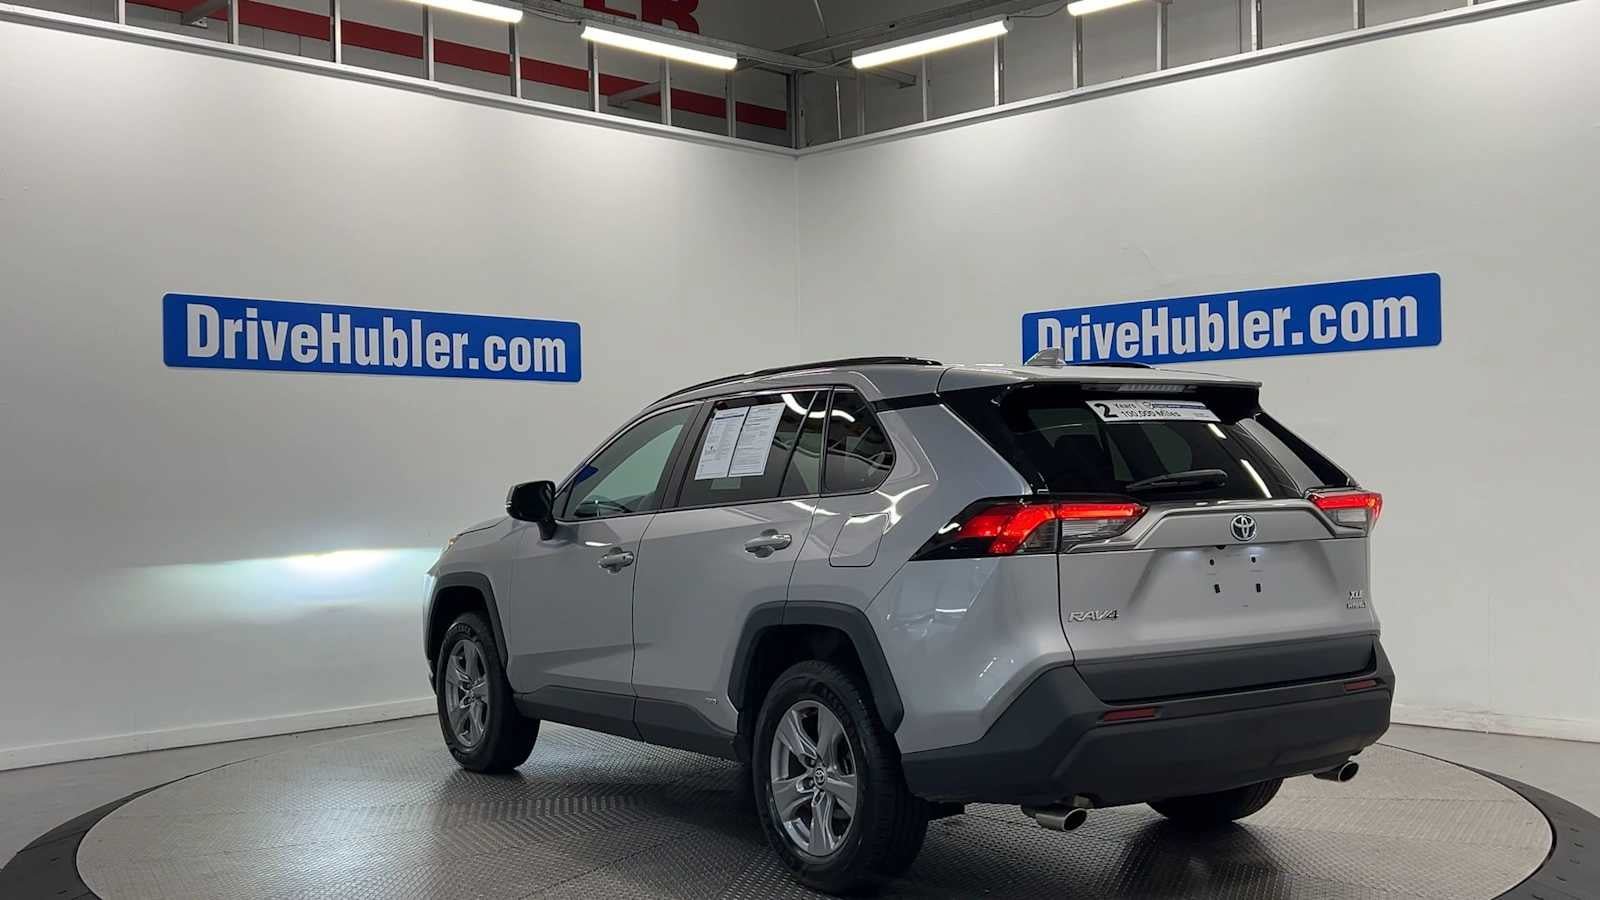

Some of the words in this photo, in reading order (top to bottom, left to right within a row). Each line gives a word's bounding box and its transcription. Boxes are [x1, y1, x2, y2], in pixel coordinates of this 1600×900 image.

[187, 303, 566, 373] DriveHubler.com
[1038, 296, 1418, 361] DriveHubler.com
[1094, 402, 1118, 418] 2
[1068, 609, 1119, 623] RAV4
